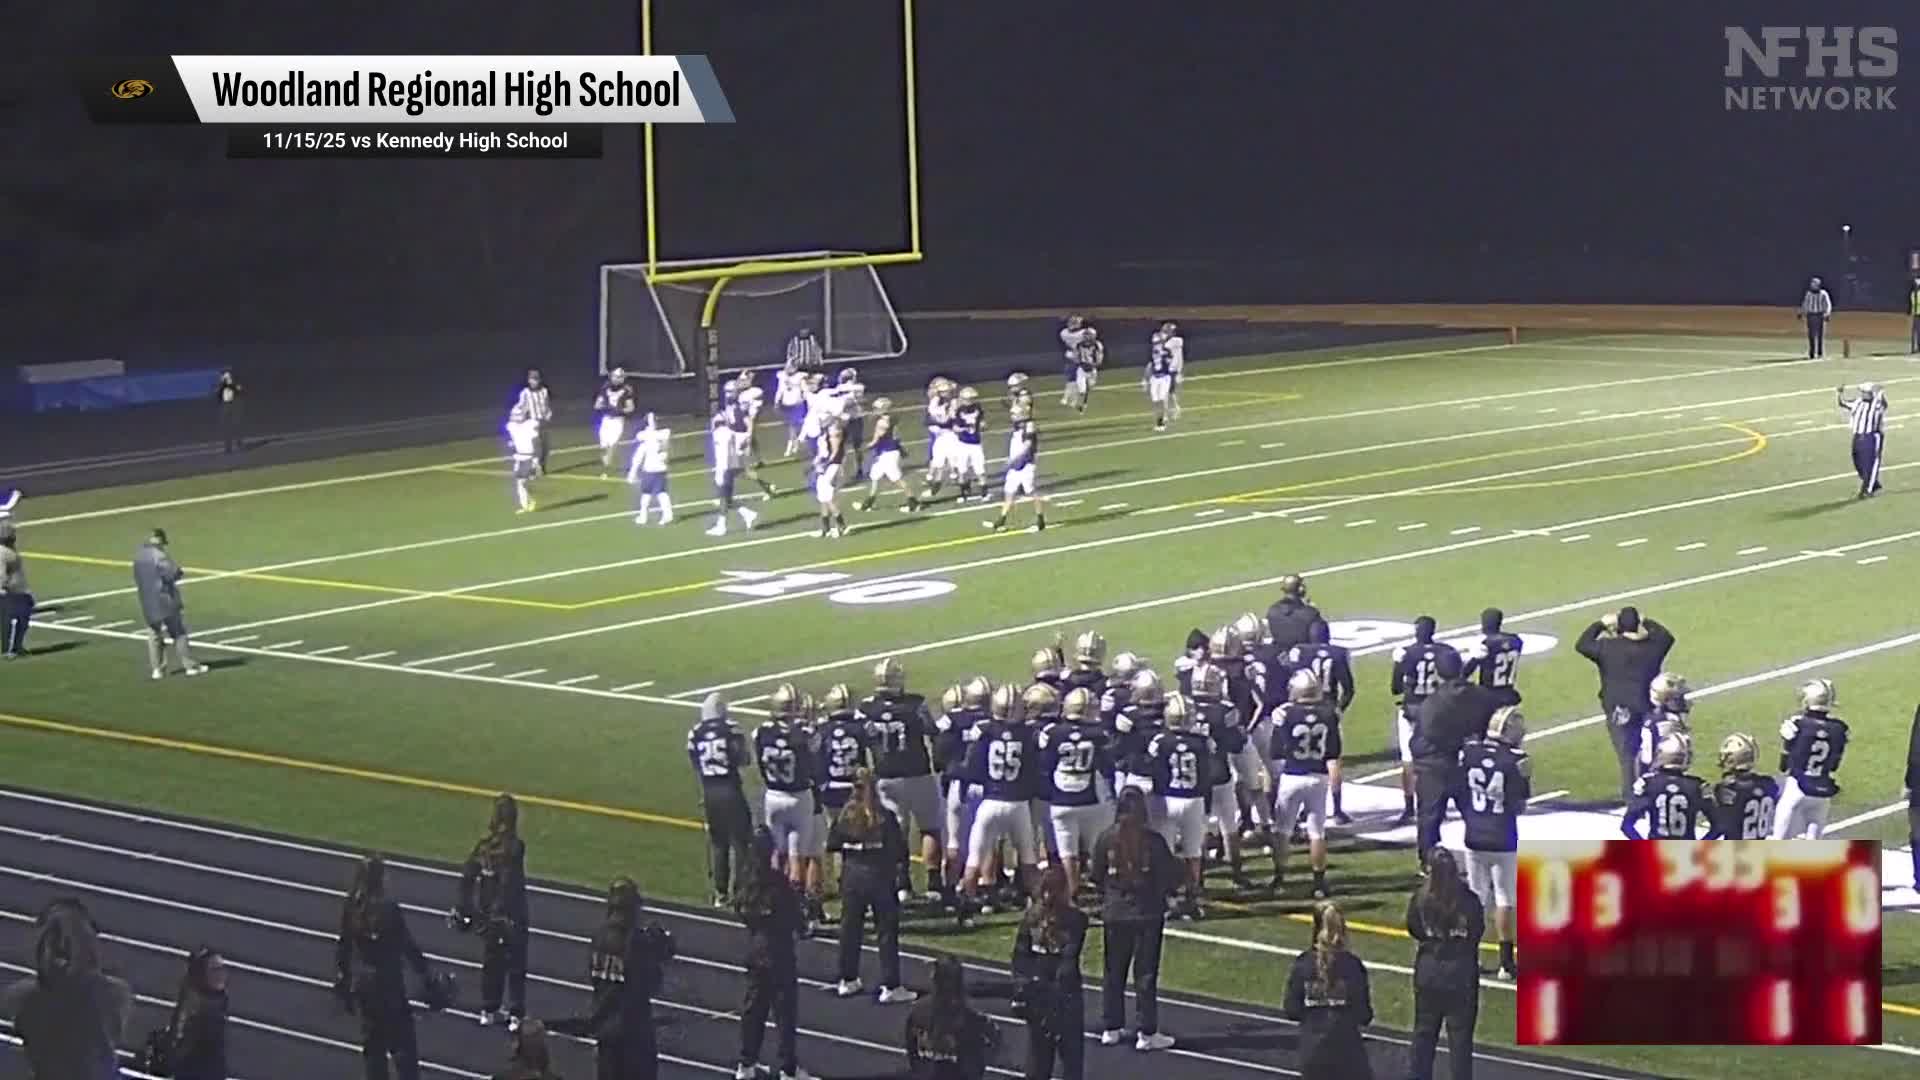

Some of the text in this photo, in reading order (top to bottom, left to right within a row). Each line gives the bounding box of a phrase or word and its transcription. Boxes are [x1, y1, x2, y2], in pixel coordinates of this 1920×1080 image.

[1493, 651, 1519, 687] 27
[697, 739, 729, 776] 25
[988, 740, 1023, 781] 65
[1057, 741, 1095, 771] 20
[1292, 724, 1328, 761] 33
[1803, 740, 1829, 776] 2
[1468, 768, 1504, 813] 64
[1655, 793, 1688, 837] 16
[1742, 797, 1774, 840] 28
